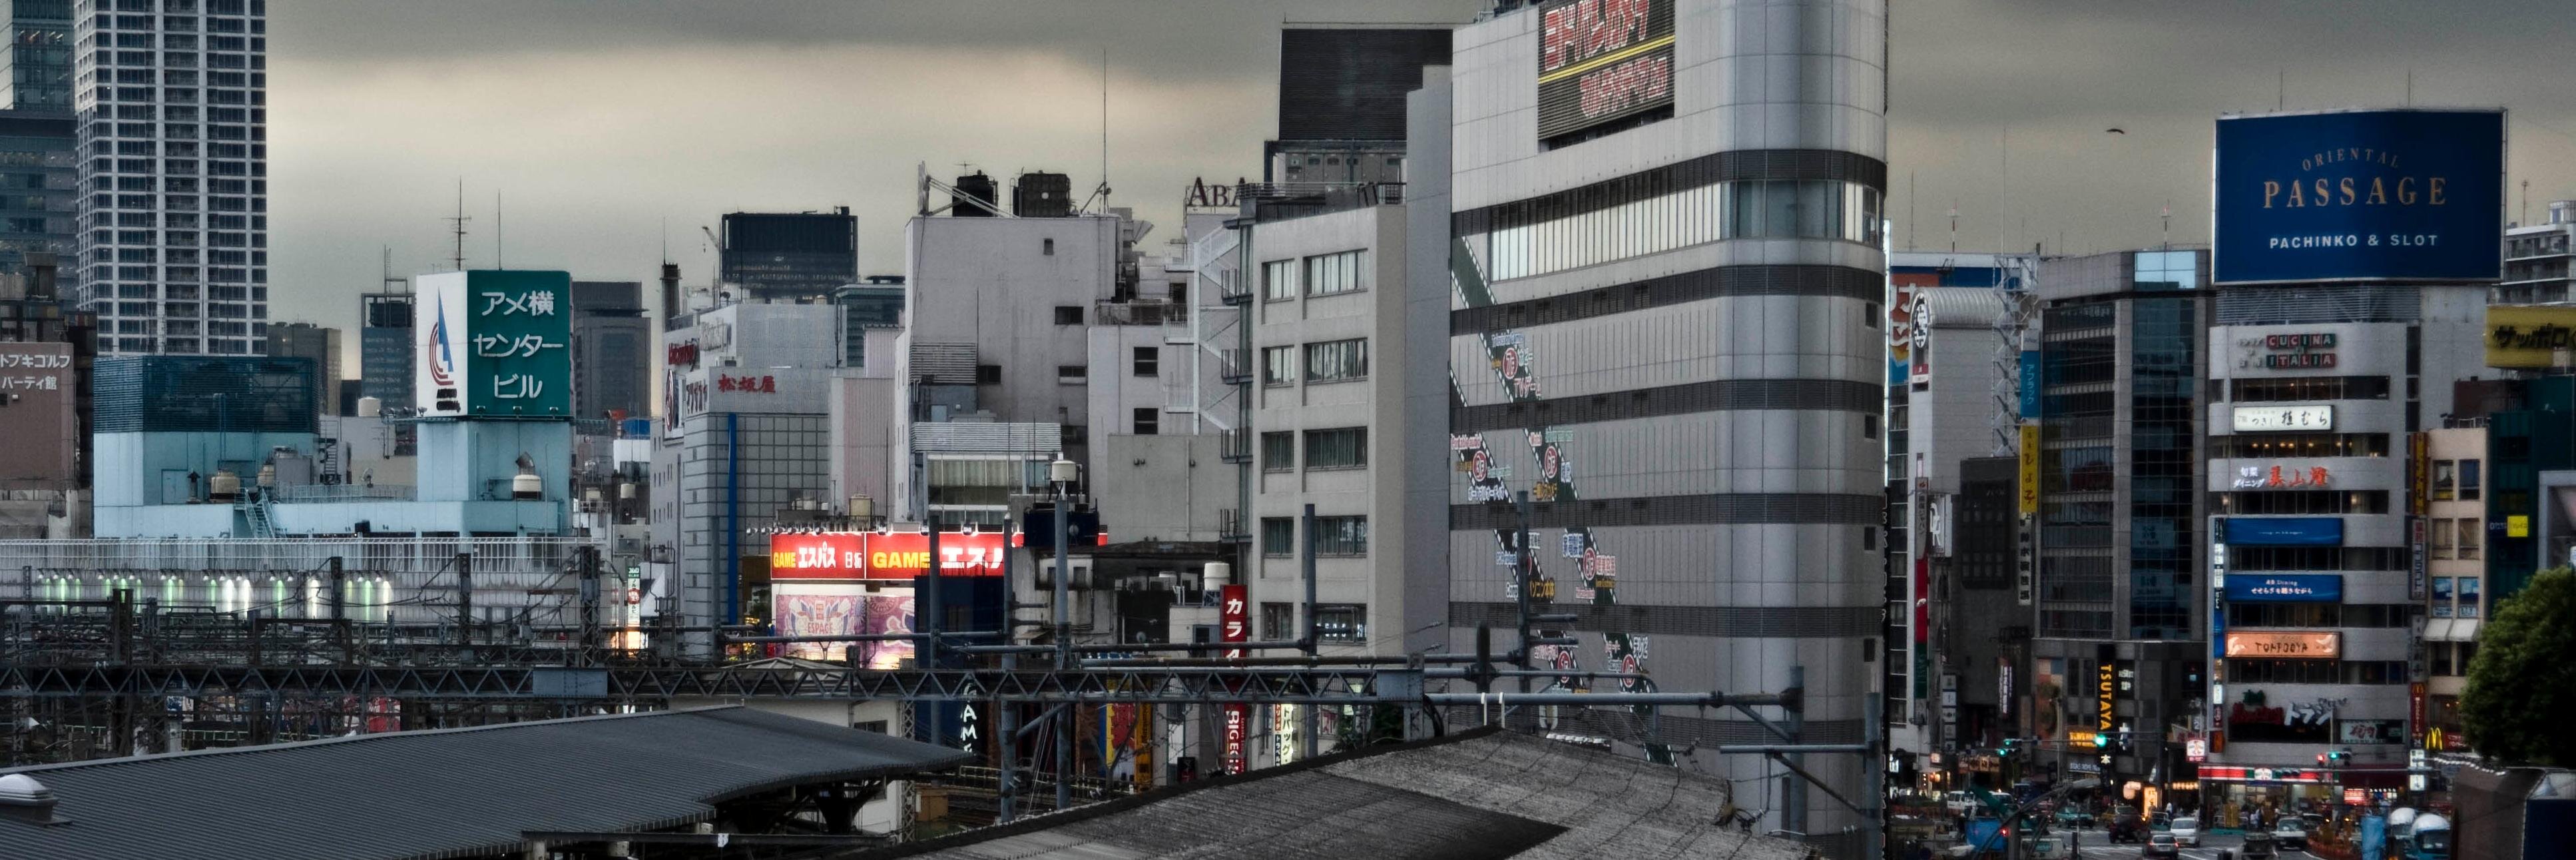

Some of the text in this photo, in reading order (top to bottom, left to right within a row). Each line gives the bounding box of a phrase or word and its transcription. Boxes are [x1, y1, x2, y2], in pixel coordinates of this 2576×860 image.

[2302, 147, 2401, 171] ORIENTAL
[2263, 177, 2448, 209] PASSAGE
[2270, 233, 2438, 250] PACHINKO & SLOT
[481, 290, 555, 316] アメ横
[473, 333, 563, 358] センター
[2268, 334, 2332, 347] CUCINA
[2269, 354, 2332, 366] ITALIA
[1, 376, 57, 390] パーティ館
[494, 374, 543, 399] ビル
[718, 373, 776, 393] 松坂屋
[2234, 478, 2265, 488] ダイニング
[773, 552, 796, 568] GAME
[798, 541, 836, 569] エスパス
[873, 552, 930, 568] GAME
[2100, 663, 2113, 730] TSUTAYA
[2100, 754, 2112, 765] 本
